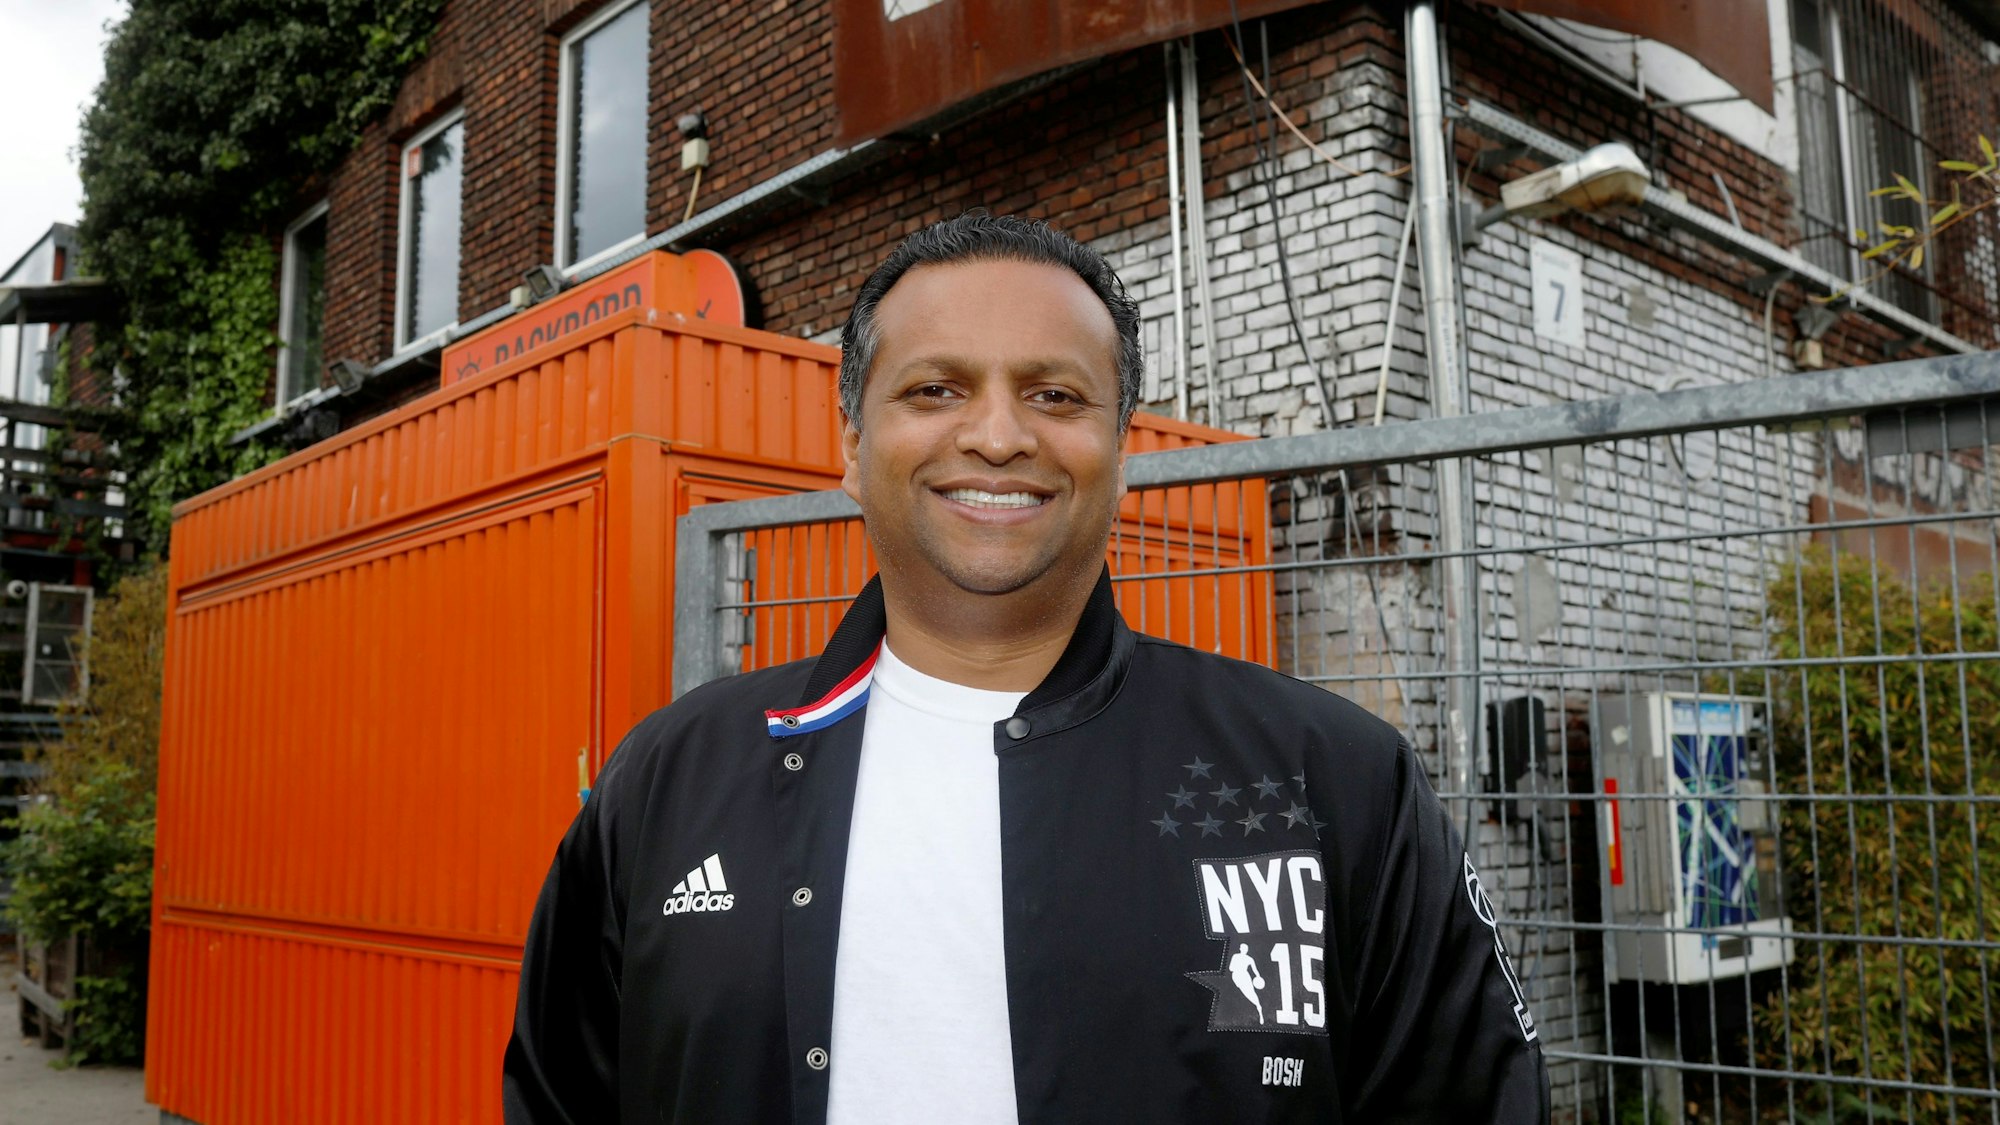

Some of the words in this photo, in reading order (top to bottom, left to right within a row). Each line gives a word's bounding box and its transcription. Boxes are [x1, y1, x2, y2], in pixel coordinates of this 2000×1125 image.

[1549, 280, 1565, 322] 7
[662, 890, 735, 916] adidas
[1200, 856, 1325, 935] NYC
[1270, 942, 1326, 1029] 15
[1261, 1056, 1305, 1087] BOSH
